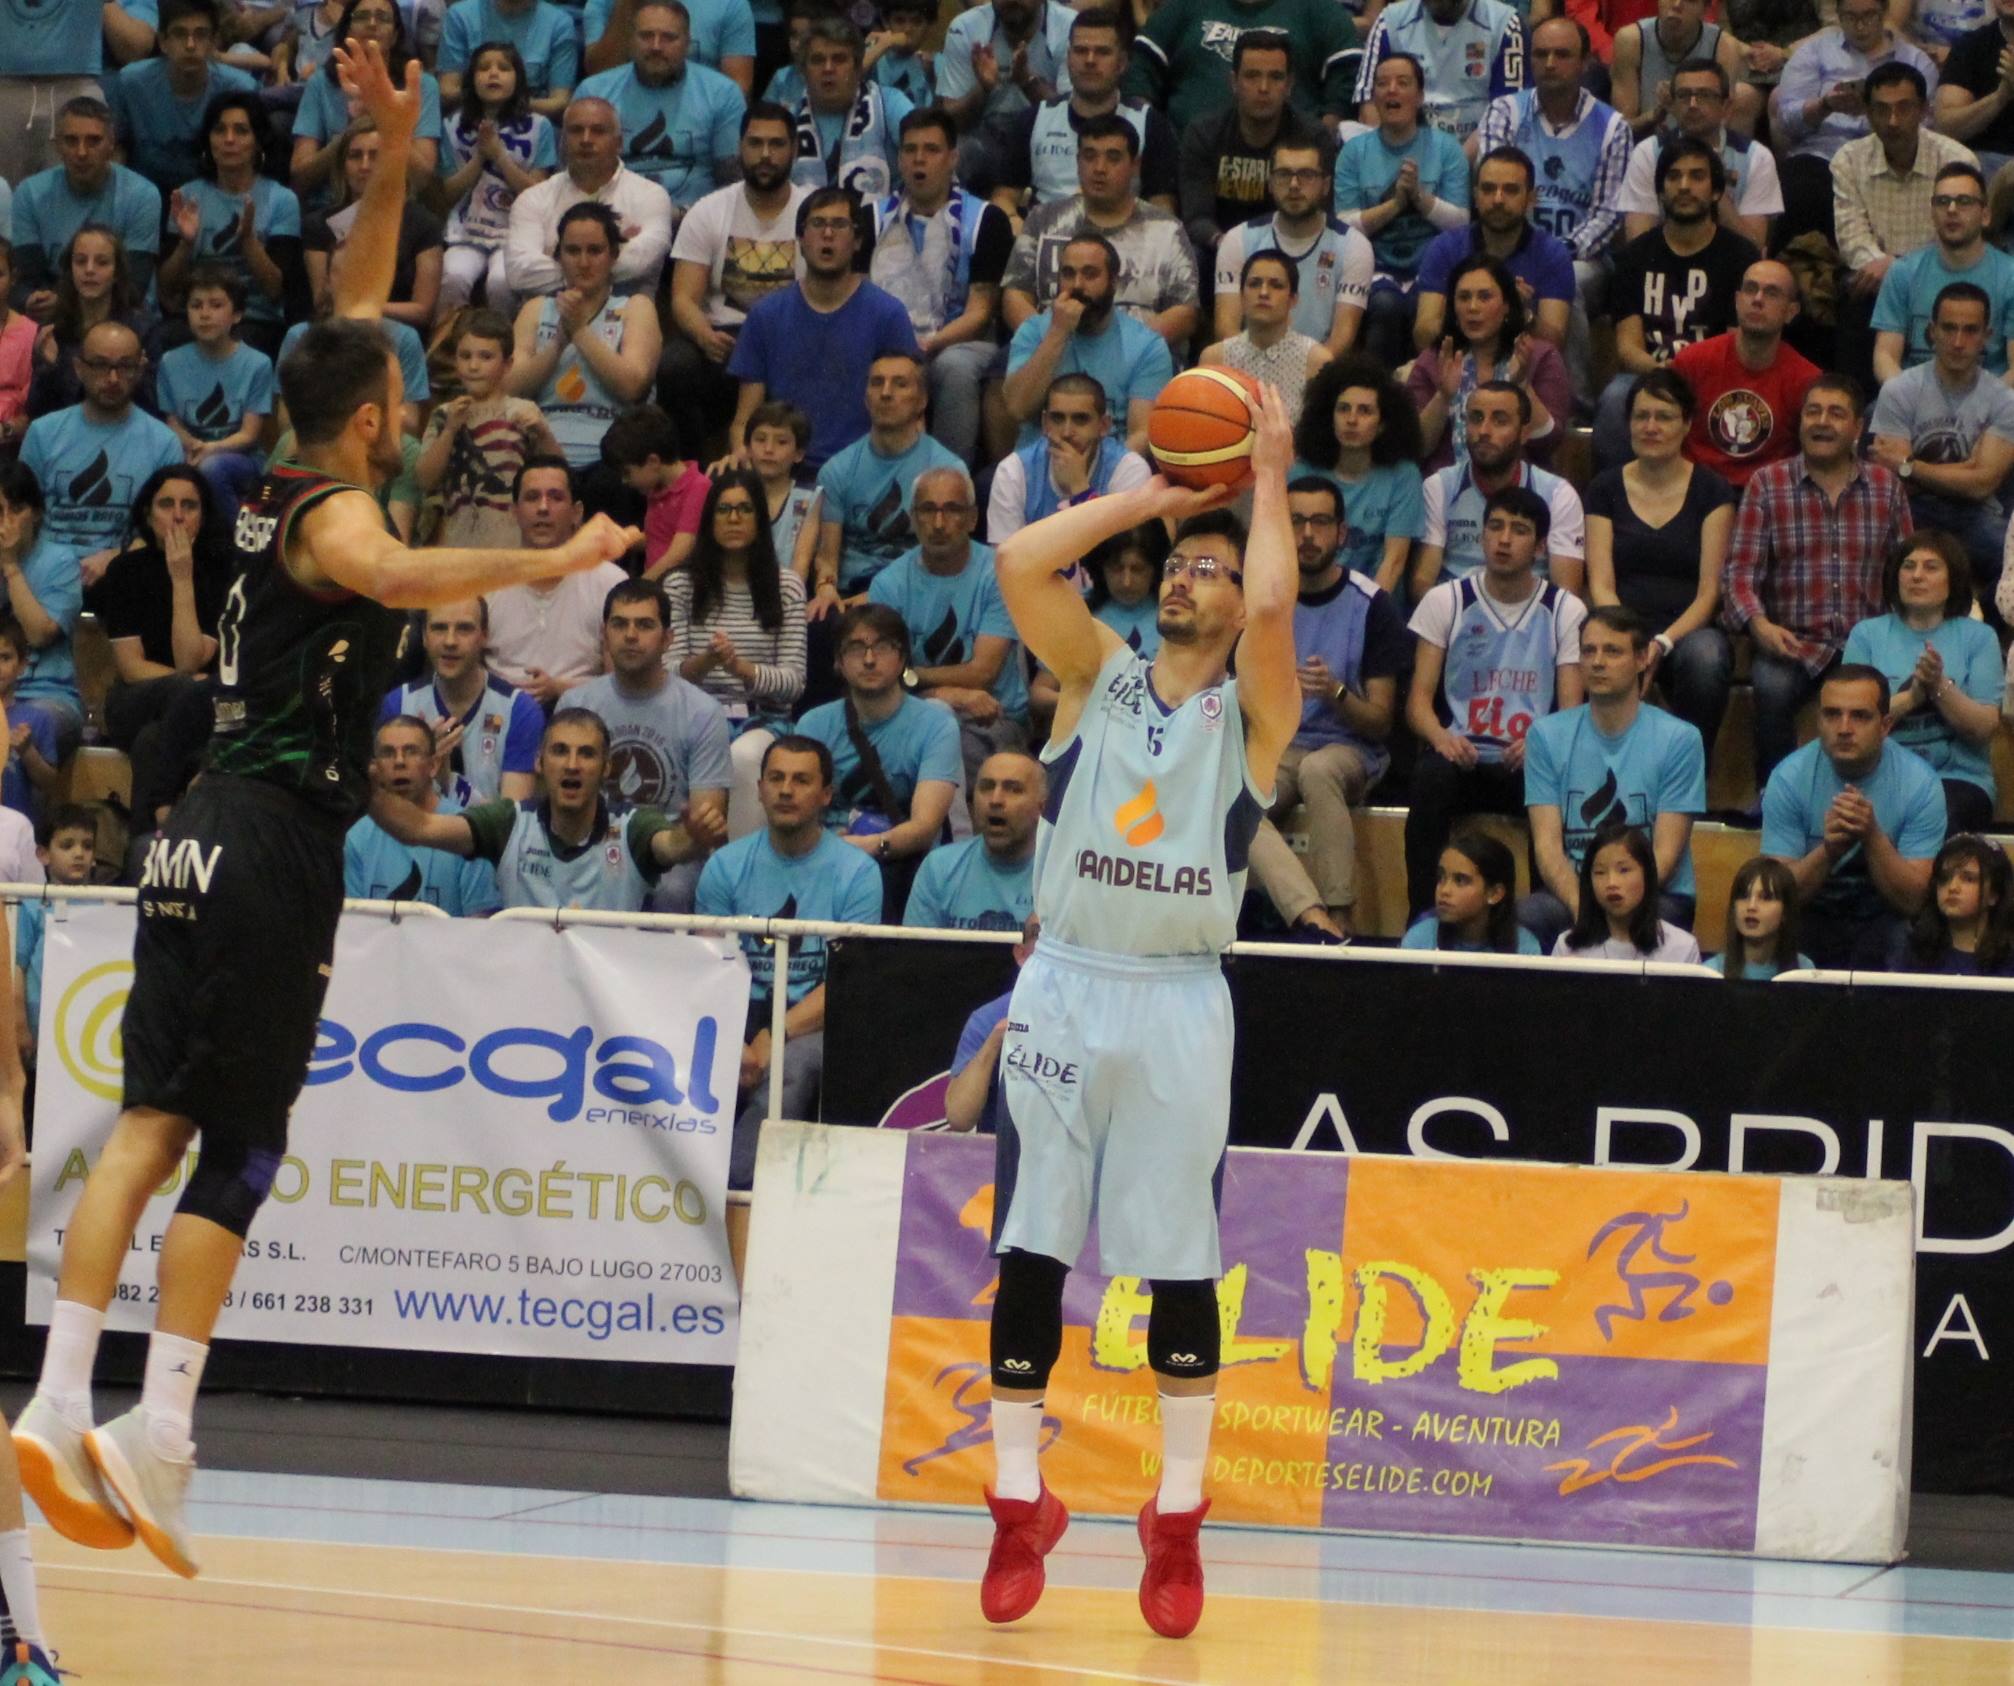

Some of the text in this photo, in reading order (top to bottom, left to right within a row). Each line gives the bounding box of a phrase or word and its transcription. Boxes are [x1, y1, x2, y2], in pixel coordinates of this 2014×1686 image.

[1075, 849, 1213, 897] ANDELAS
[301, 1016, 720, 1123] ecgal
[329, 1158, 709, 1226] ENERGÉTICO
[339, 1245, 723, 1284] C/MONTEFARO 5 BAJO LUGO 27003
[252, 1290, 289, 1311] 661
[294, 1293, 331, 1314] 238
[338, 1296, 374, 1316] 331
[394, 1288, 726, 1340] www.tecgal.es
[1218, 1401, 1385, 1441] SPORTWEAR
[1411, 1410, 1561, 1449] AVENTURA
